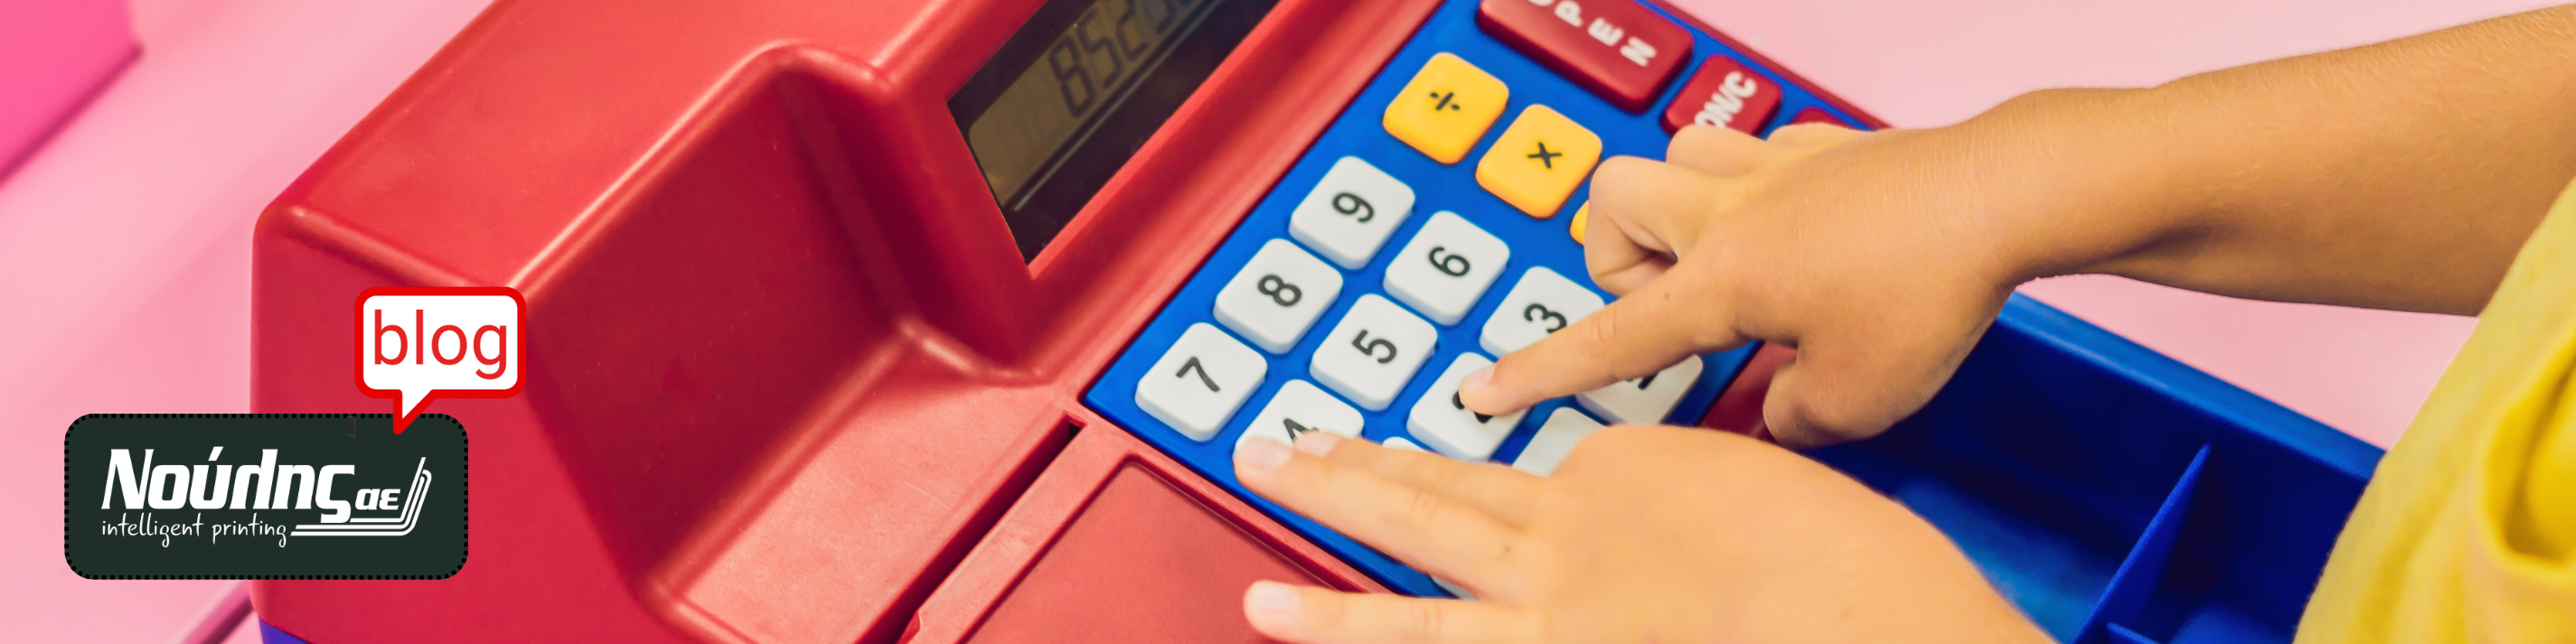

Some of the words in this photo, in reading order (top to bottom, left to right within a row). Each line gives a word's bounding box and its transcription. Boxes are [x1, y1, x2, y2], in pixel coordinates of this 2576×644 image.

[1528, 0, 1657, 67] PEN
[1331, 191, 1375, 224] 9
[1428, 246, 1471, 278] 6
[1256, 274, 1302, 308] 8
[1523, 303, 1567, 335] 3
[1351, 329, 1397, 365] 5
[1175, 356, 1221, 393] 7
